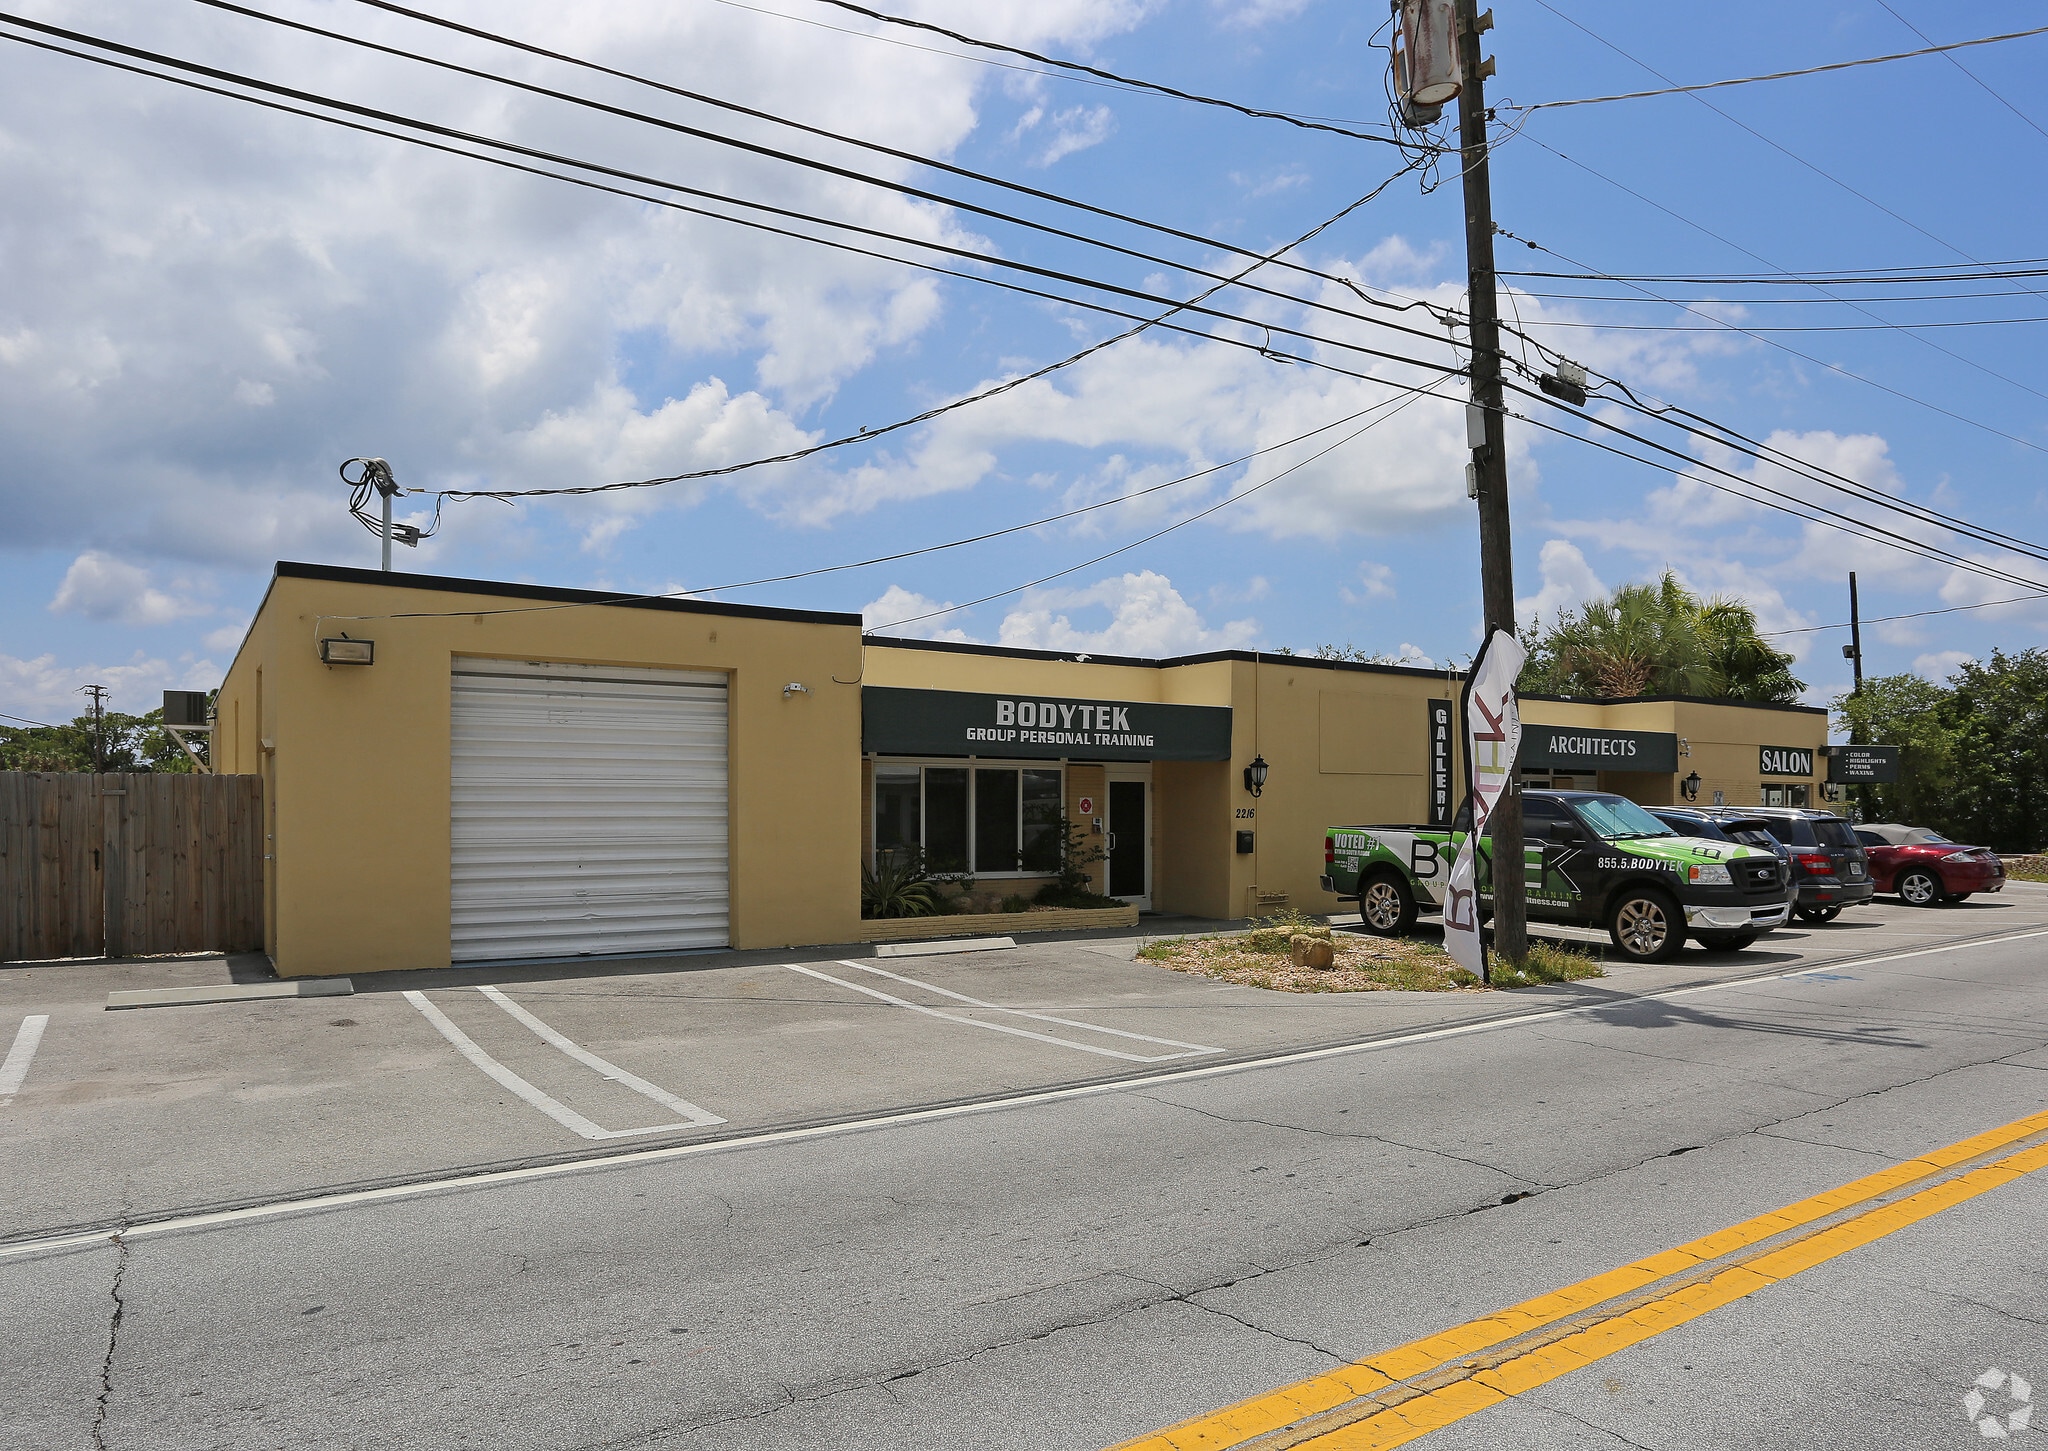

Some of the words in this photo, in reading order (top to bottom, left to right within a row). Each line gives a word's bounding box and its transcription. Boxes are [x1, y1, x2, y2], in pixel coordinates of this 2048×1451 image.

[996, 700, 1131, 731] BODYTEK
[966, 727, 1016, 742] GROUP
[1020, 729, 1092, 745] PERSONAL
[1094, 732, 1154, 747] TRAINING
[1549, 735, 1637, 756] ARCHITECTS
[1435, 708, 1447, 821] GALLERY
[1761, 750, 1811, 774] SALON
[1236, 808, 1255, 819] 2216
[1334, 833, 1365, 849] VOTED
[1366, 836, 1381, 851] #1
[1597, 857, 1684, 872] 855.5.BODYTEK
[1526, 889, 1582, 901] RAINING
